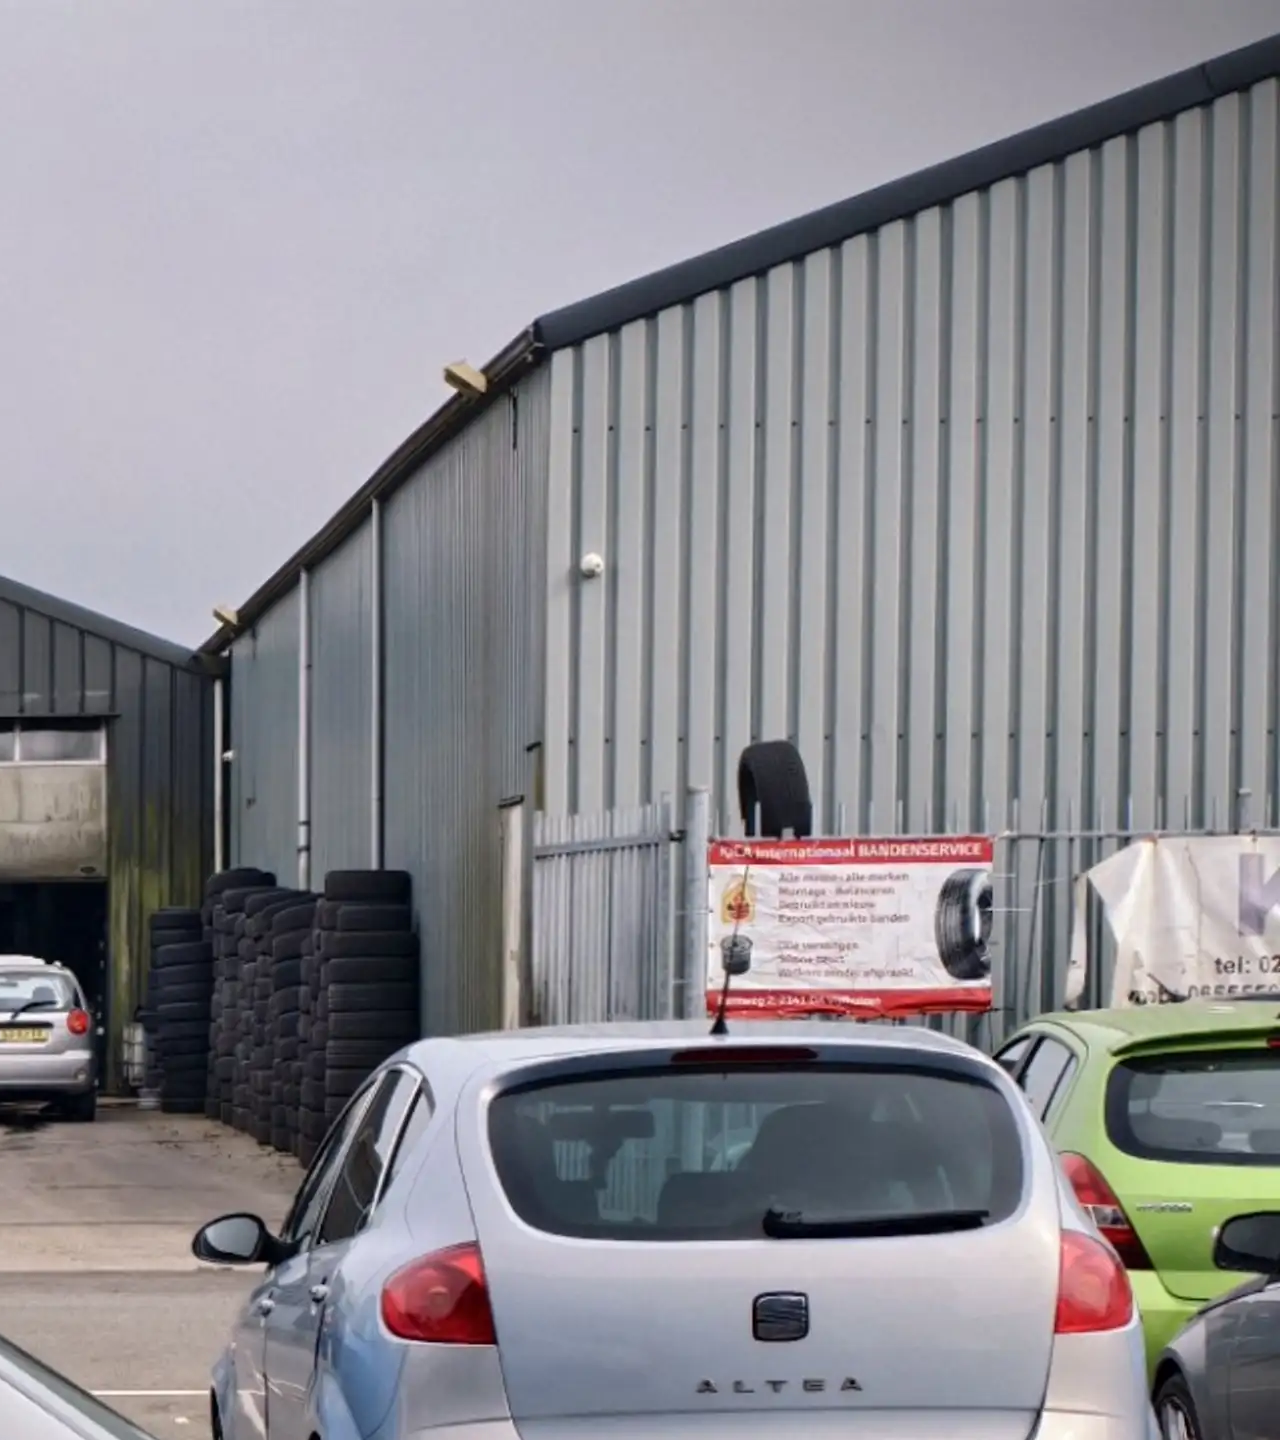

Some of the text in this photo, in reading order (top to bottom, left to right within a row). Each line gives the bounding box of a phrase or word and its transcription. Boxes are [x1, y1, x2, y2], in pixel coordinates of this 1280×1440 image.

[859, 842, 983, 858] BANDENSERVICE
[1214, 956, 1252, 974] tel:
[696, 1377, 863, 1394] ALTEA
